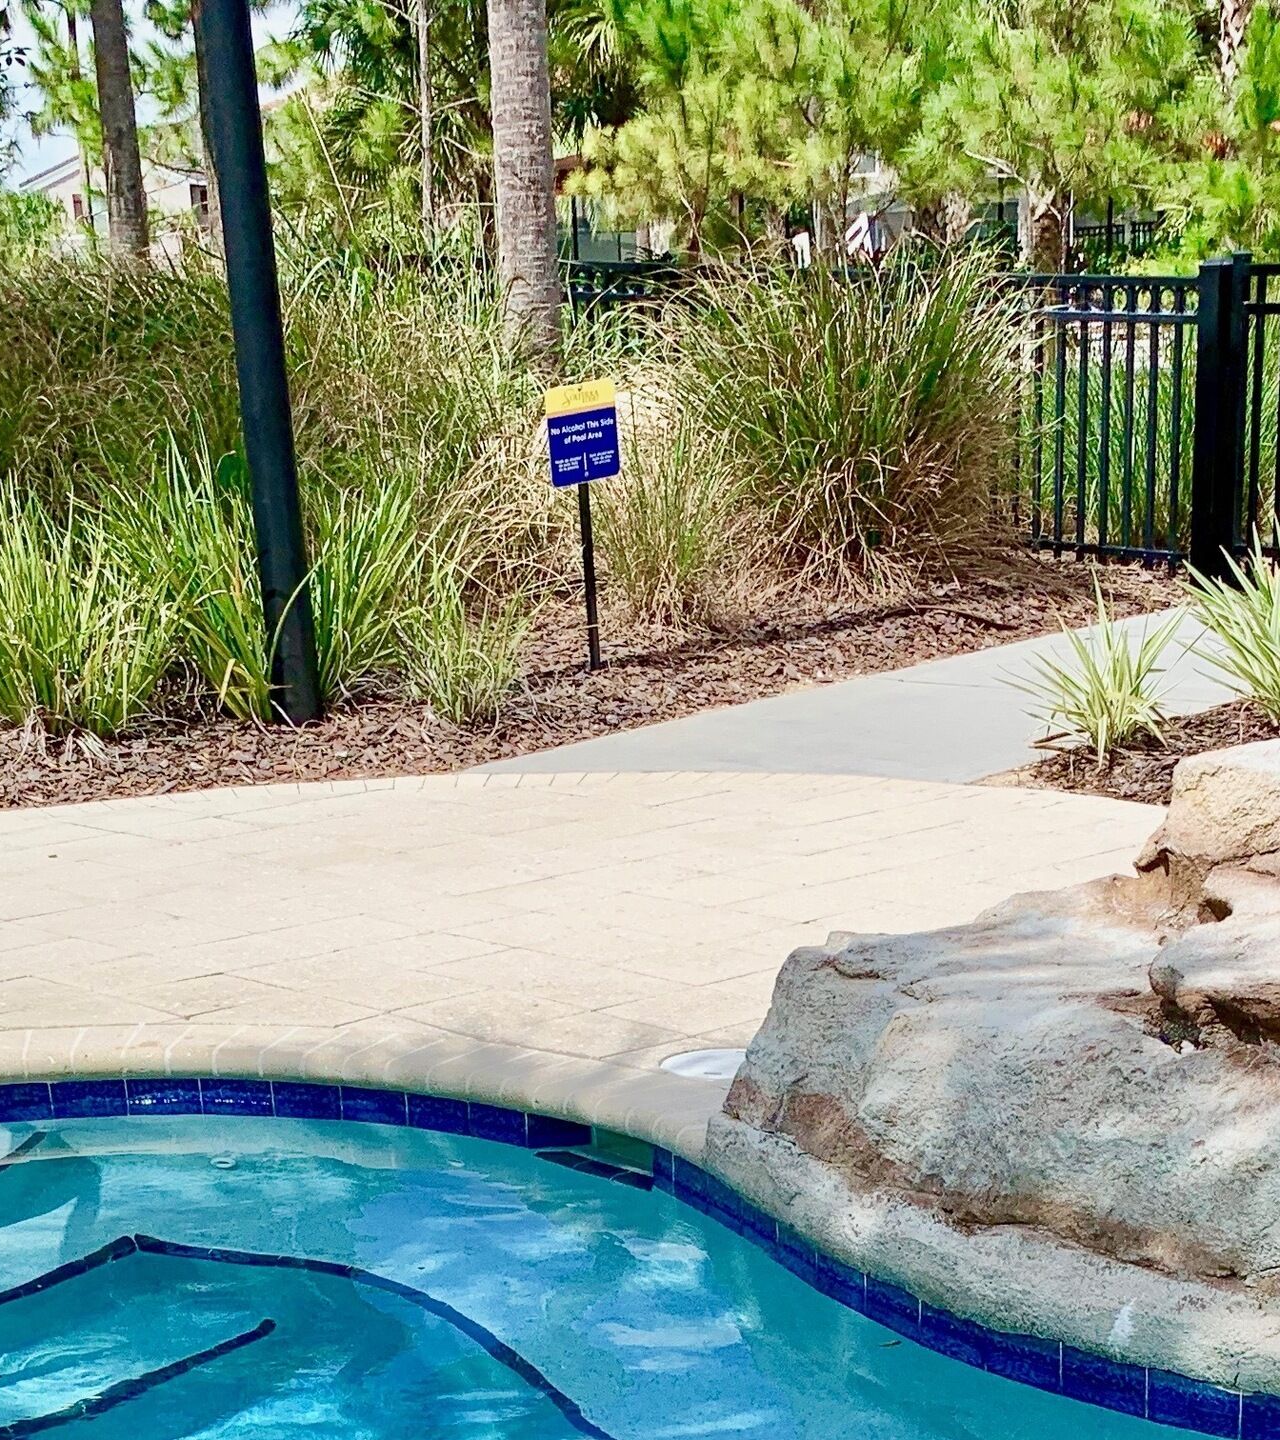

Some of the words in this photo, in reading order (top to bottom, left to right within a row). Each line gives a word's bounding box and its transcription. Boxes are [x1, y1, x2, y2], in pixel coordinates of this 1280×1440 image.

[562, 422, 586, 433] Alcohol
[586, 420, 599, 429] This
[600, 418, 614, 426] Side
[572, 433, 587, 442] Pool
[587, 431, 603, 440] Area
